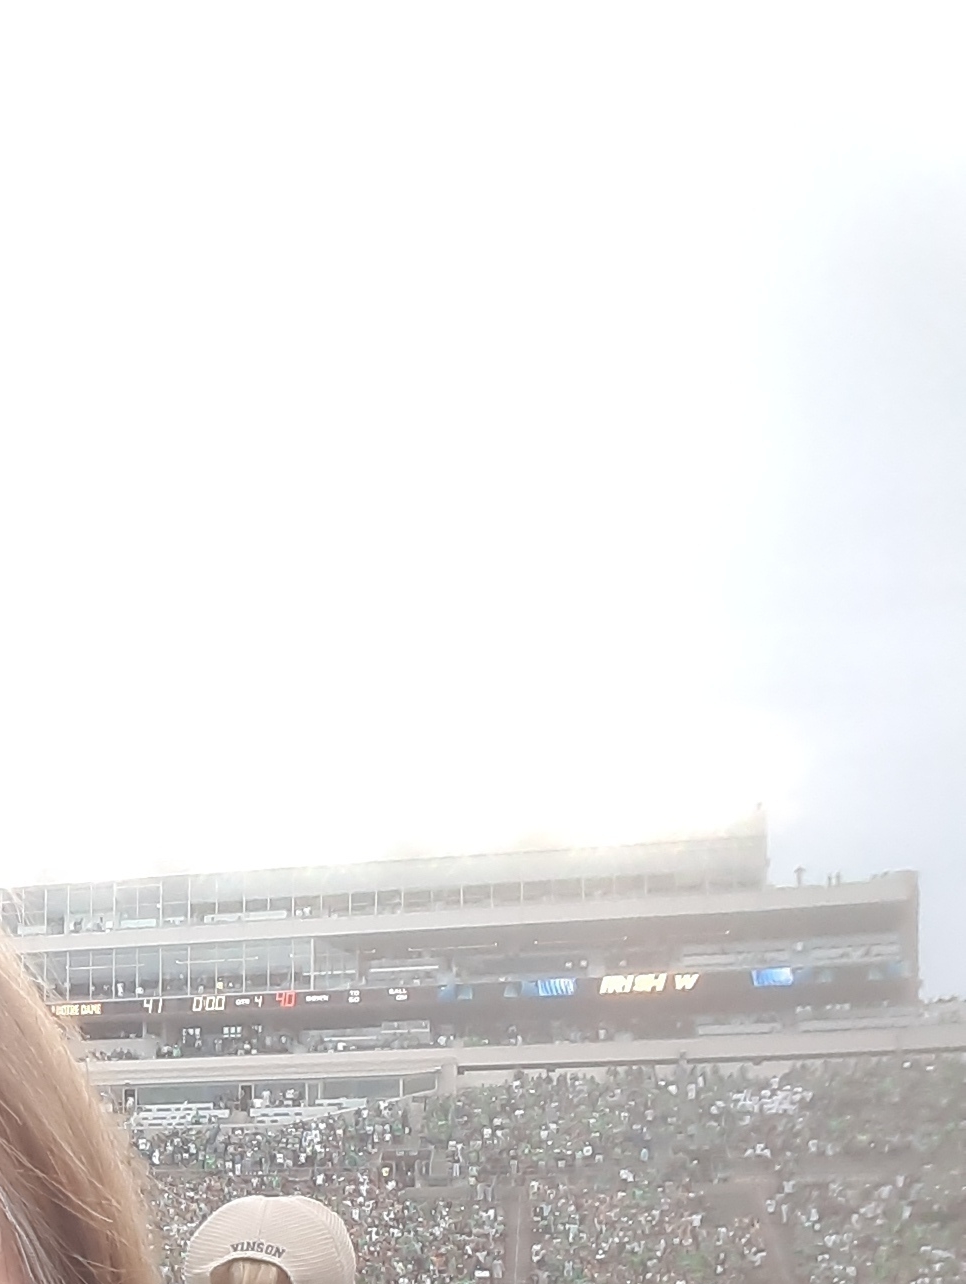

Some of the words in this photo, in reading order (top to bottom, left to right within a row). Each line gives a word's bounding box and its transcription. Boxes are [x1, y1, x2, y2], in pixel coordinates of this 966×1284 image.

[599, 972, 668, 995] IRISH
[143, 998, 163, 1014] 41
[254, 995, 263, 1008] 4
[275, 991, 296, 1007] 40
[80, 1003, 102, 1015] DAME
[230, 1240, 286, 1258] VINSON
